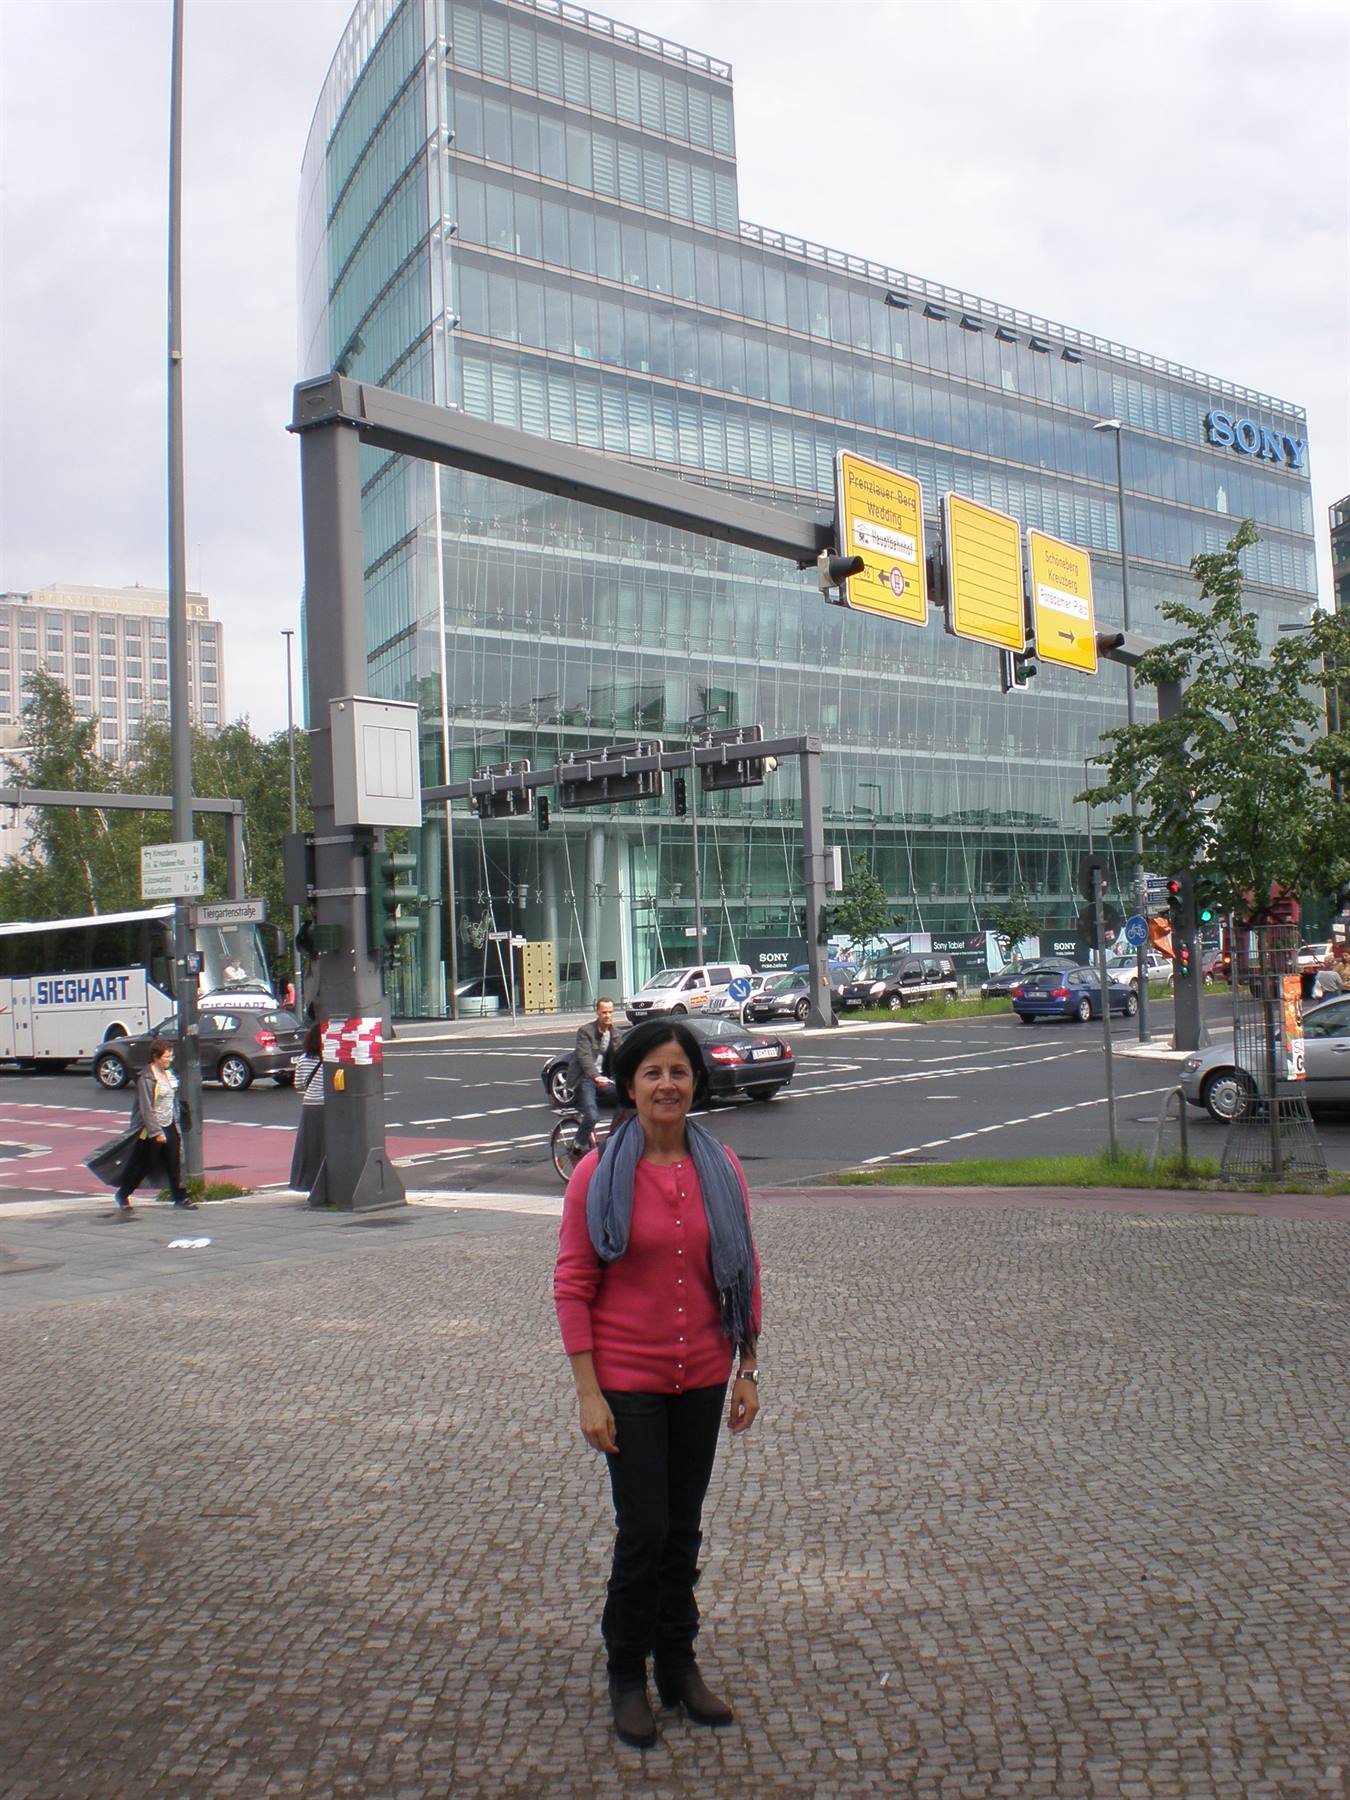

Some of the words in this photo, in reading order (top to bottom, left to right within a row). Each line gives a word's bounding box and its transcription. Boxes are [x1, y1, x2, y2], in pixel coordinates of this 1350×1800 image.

[1206, 410, 1309, 468] SONY
[848, 471, 895, 501] Prenzlauer
[897, 489, 917, 512] Berg
[867, 501, 902, 529] Wedding
[1045, 550, 1079, 577] Schöneberg
[1048, 568, 1078, 594] Kreuzberg
[203, 904, 256, 922] Tiergartenstraße
[759, 953, 789, 962] SONY
[933, 941, 947, 951] Sony
[947, 941, 965, 949] Tablet
[1053, 942, 1076, 950] SONY
[37, 976, 129, 1005] SIEGHART
